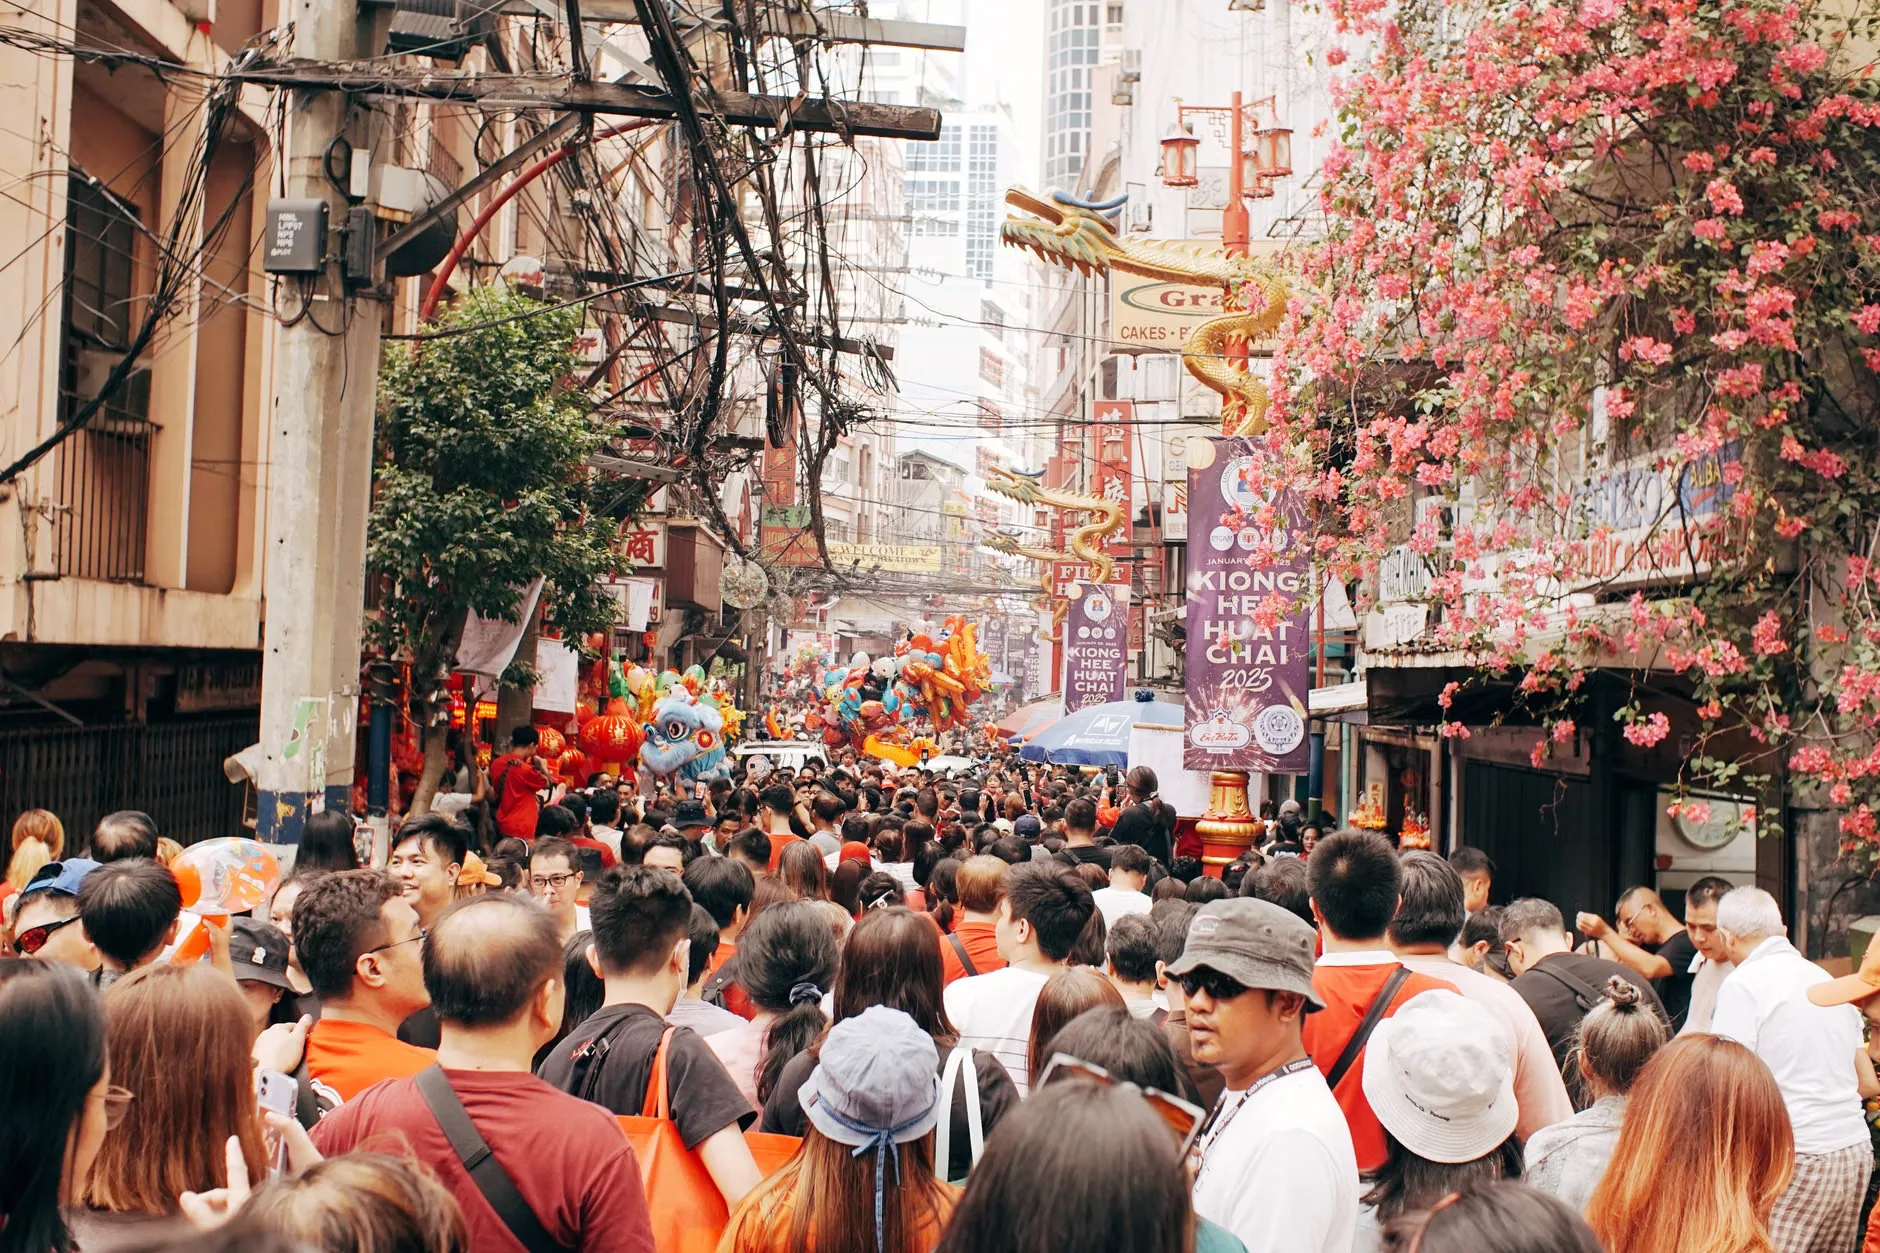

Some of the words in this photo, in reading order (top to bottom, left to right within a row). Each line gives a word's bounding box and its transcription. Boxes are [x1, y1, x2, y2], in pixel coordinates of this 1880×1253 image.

[1159, 290, 1225, 307] Gra
[1120, 326, 1167, 340] CAKES
[1690, 456, 1722, 489] ALBA
[626, 526, 659, 564] 商
[1207, 557, 1249, 566] JANUARY
[1060, 565, 1124, 581] FIT
[1196, 571, 1300, 592] KIONG
[1217, 595, 1261, 616] HE
[1204, 620, 1294, 641] HUAT
[1069, 647, 1121, 659] KIONG
[1206, 644, 1288, 665] CHAI
[1025, 658, 1040, 666] KIO
[1081, 658, 1112, 670] HEE
[1074, 670, 1117, 681] HUAT
[1219, 667, 1274, 692] 2025
[1075, 681, 1114, 692] CHAI
[1081, 693, 1107, 704] 2025
